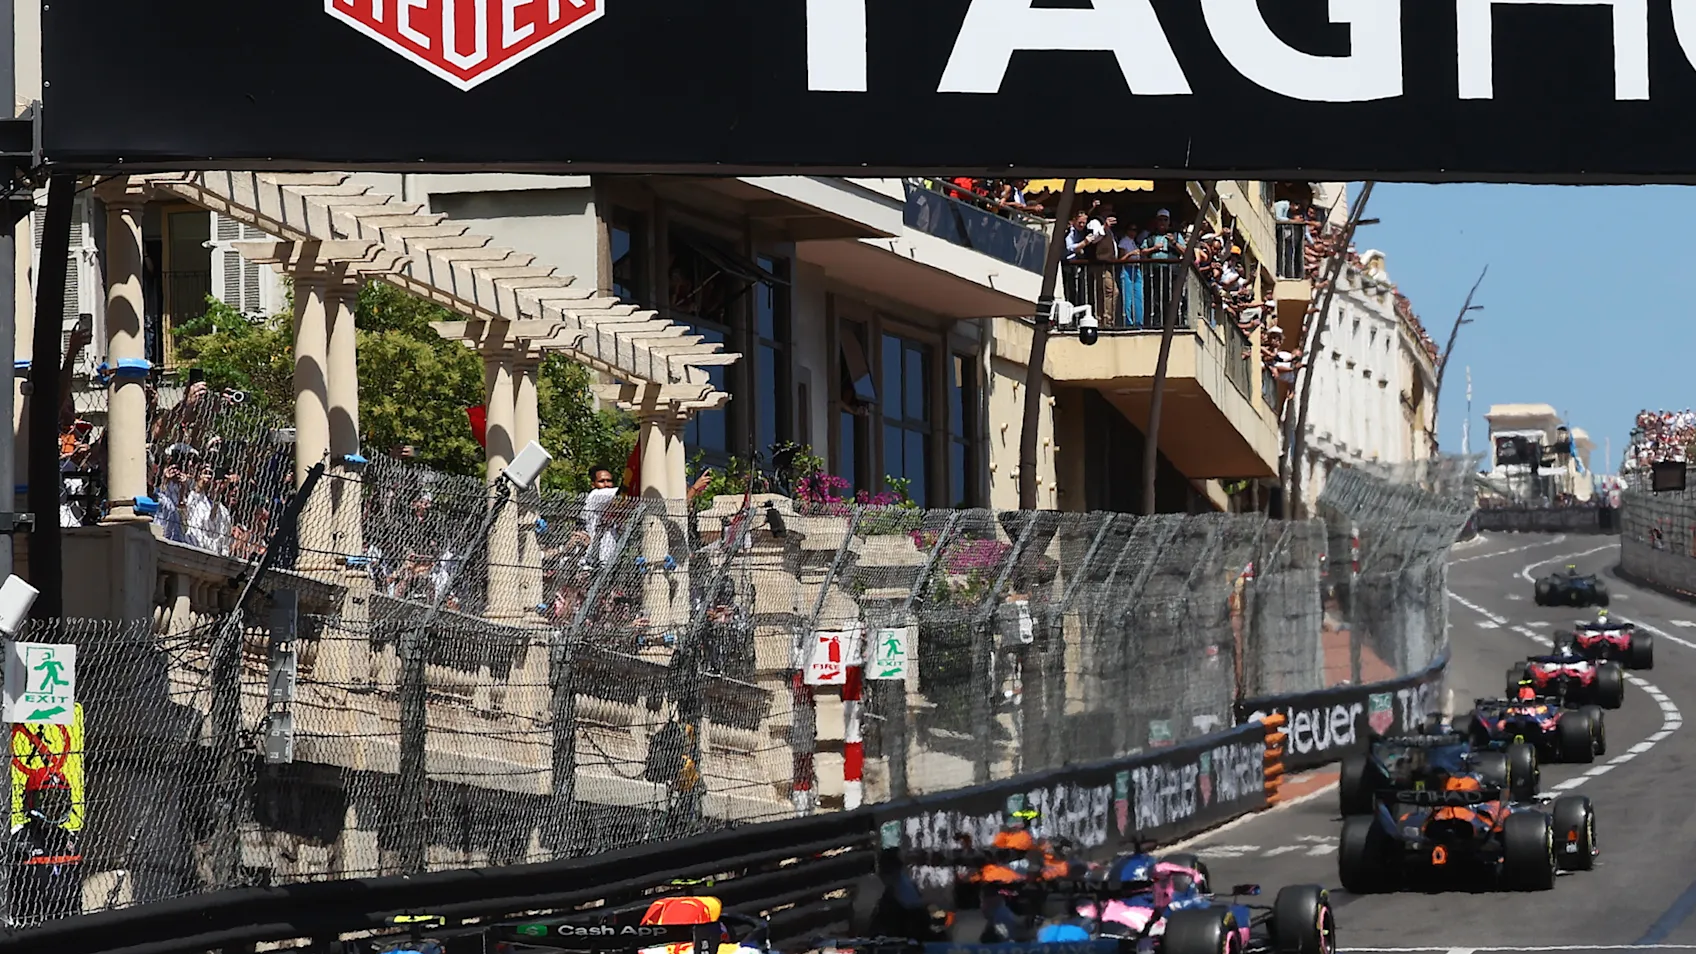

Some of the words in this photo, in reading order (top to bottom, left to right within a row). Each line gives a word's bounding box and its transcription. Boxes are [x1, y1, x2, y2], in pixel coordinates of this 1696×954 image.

[813, 663, 841, 671] FIRE
[25, 695, 69, 704] EXIT
[557, 924, 617, 937] Cash
[620, 924, 668, 938] App
